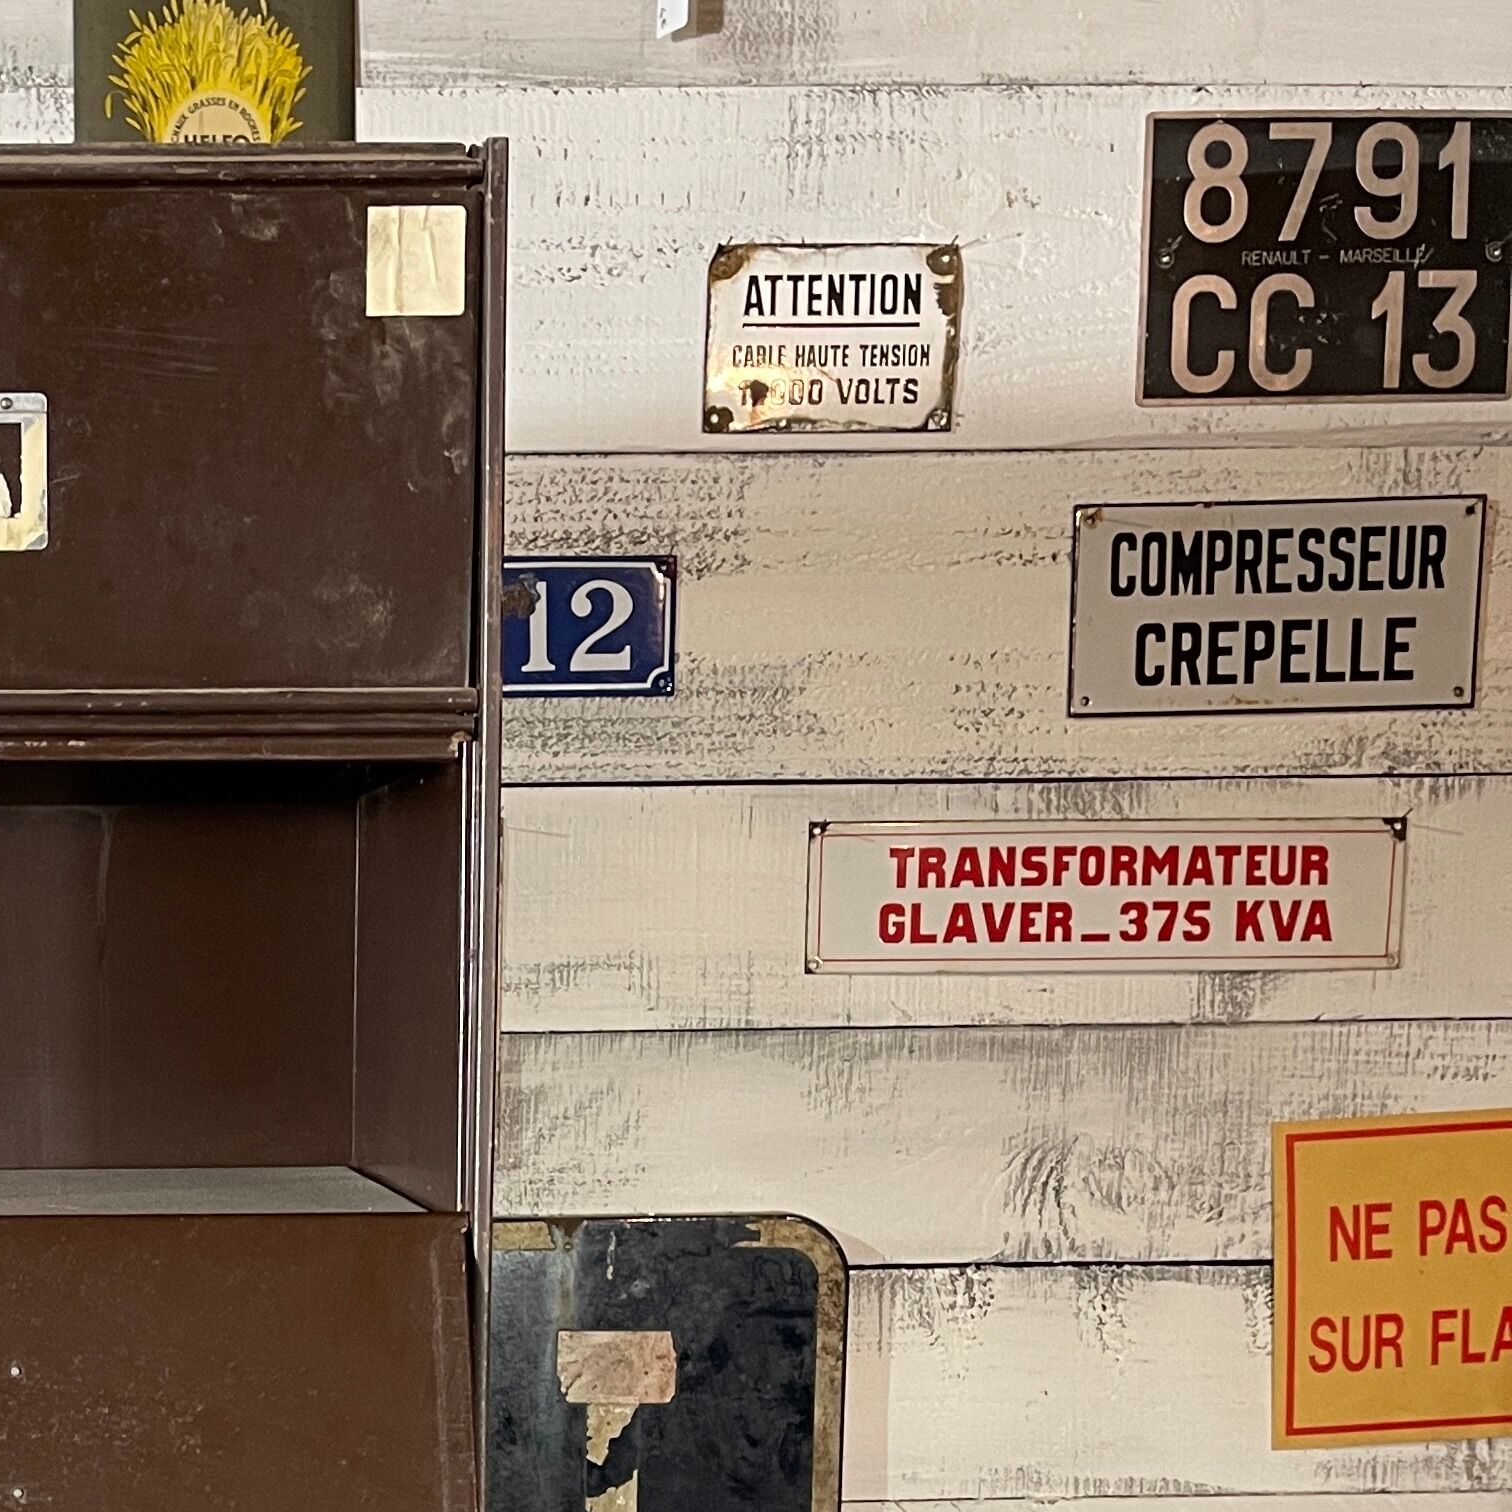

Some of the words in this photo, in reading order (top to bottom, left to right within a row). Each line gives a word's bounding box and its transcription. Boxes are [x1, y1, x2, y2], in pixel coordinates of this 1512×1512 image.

[1184, 120, 1472, 244] 8791
[1241, 250, 1312, 266] RENAULT
[744, 273, 922, 316] ATTENTION
[732, 345, 786, 368] CABLE
[795, 345, 849, 367] HAUTE
[860, 344, 931, 367] TENSION
[1170, 273, 1316, 394] CC
[1371, 270, 1478, 389] 13
[838, 378, 920, 405] VOLTS
[1110, 524, 1448, 597] COMPRESSEUR
[1135, 617, 1417, 687] CREPELLE
[889, 845, 1330, 890] TRANSFORMATEUR
[1234, 900, 1333, 943] KVA
[1329, 1202, 1393, 1262] NE
[1419, 1195, 1508, 1257] PAS
[1309, 1312, 1404, 1373] SUR
